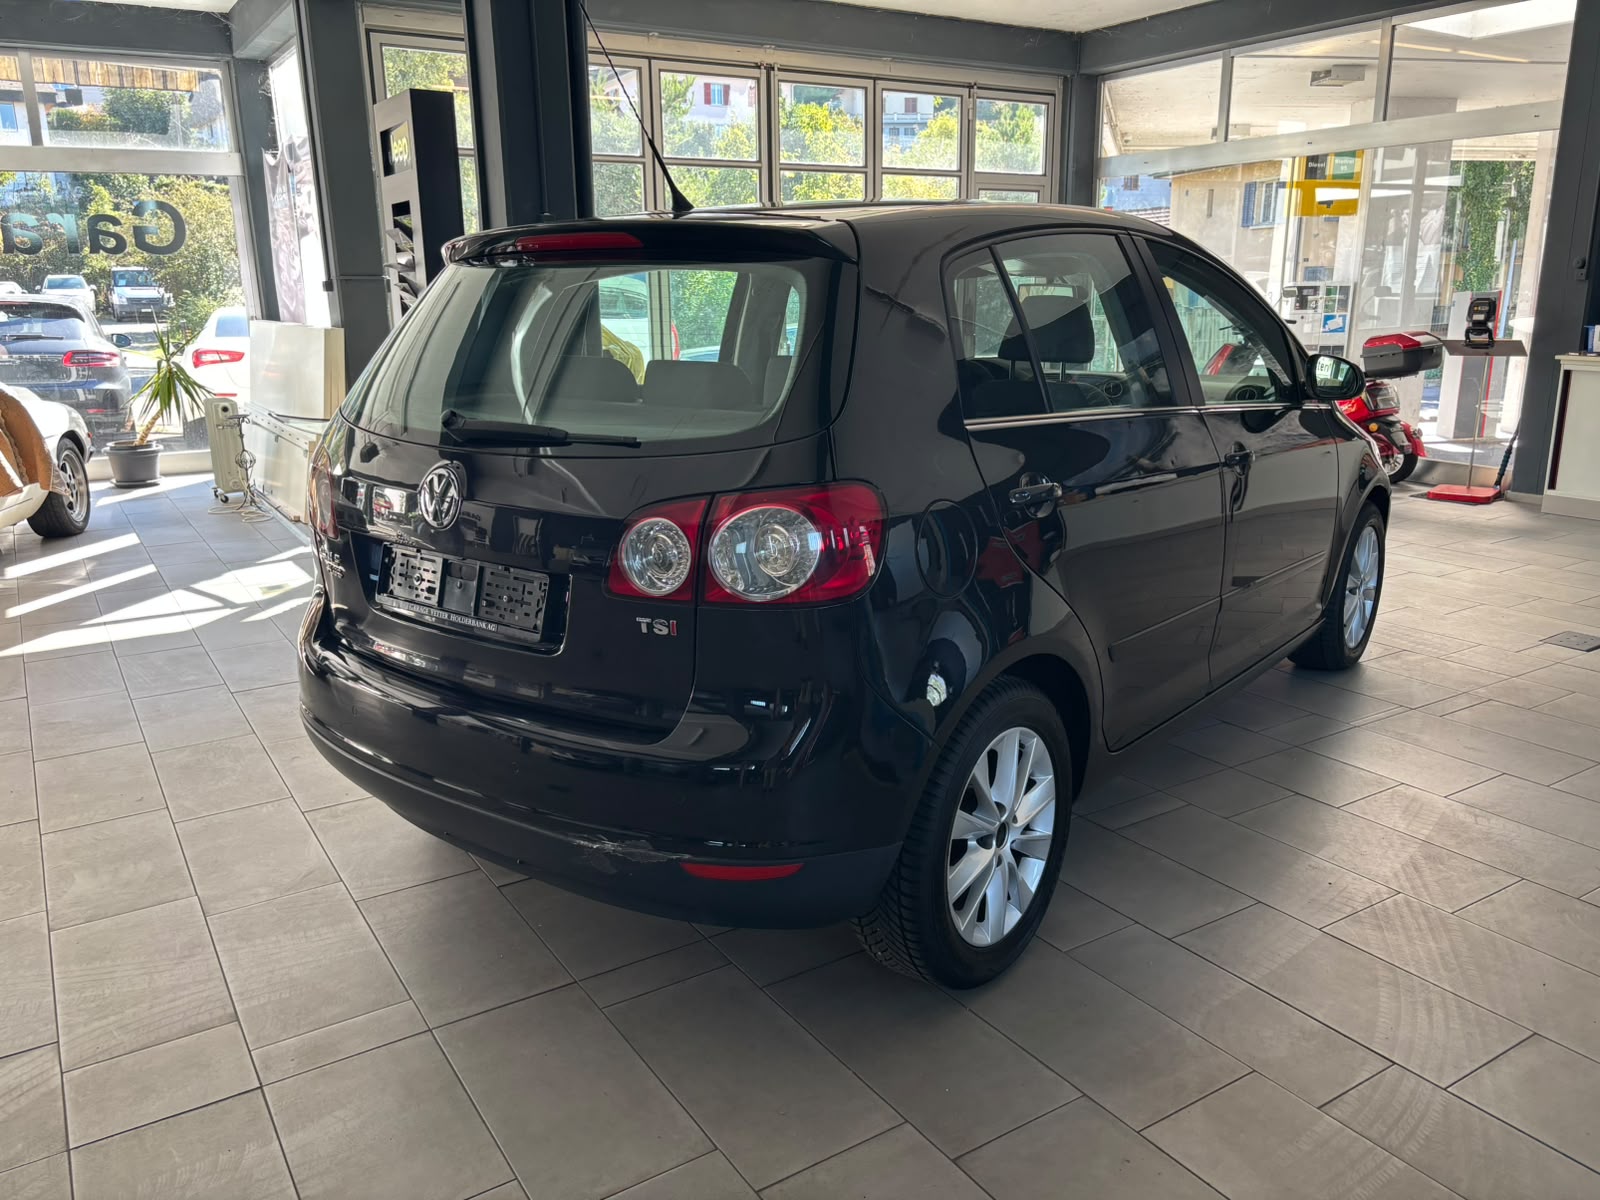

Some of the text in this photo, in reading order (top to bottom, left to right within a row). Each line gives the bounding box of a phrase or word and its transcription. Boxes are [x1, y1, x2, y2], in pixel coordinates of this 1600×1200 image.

[409, 604, 429, 614] GARAGE
[450, 614, 487, 629] HOLDERBANK
[487, 623, 496, 632] AG
[636, 617, 677, 636] TSI
